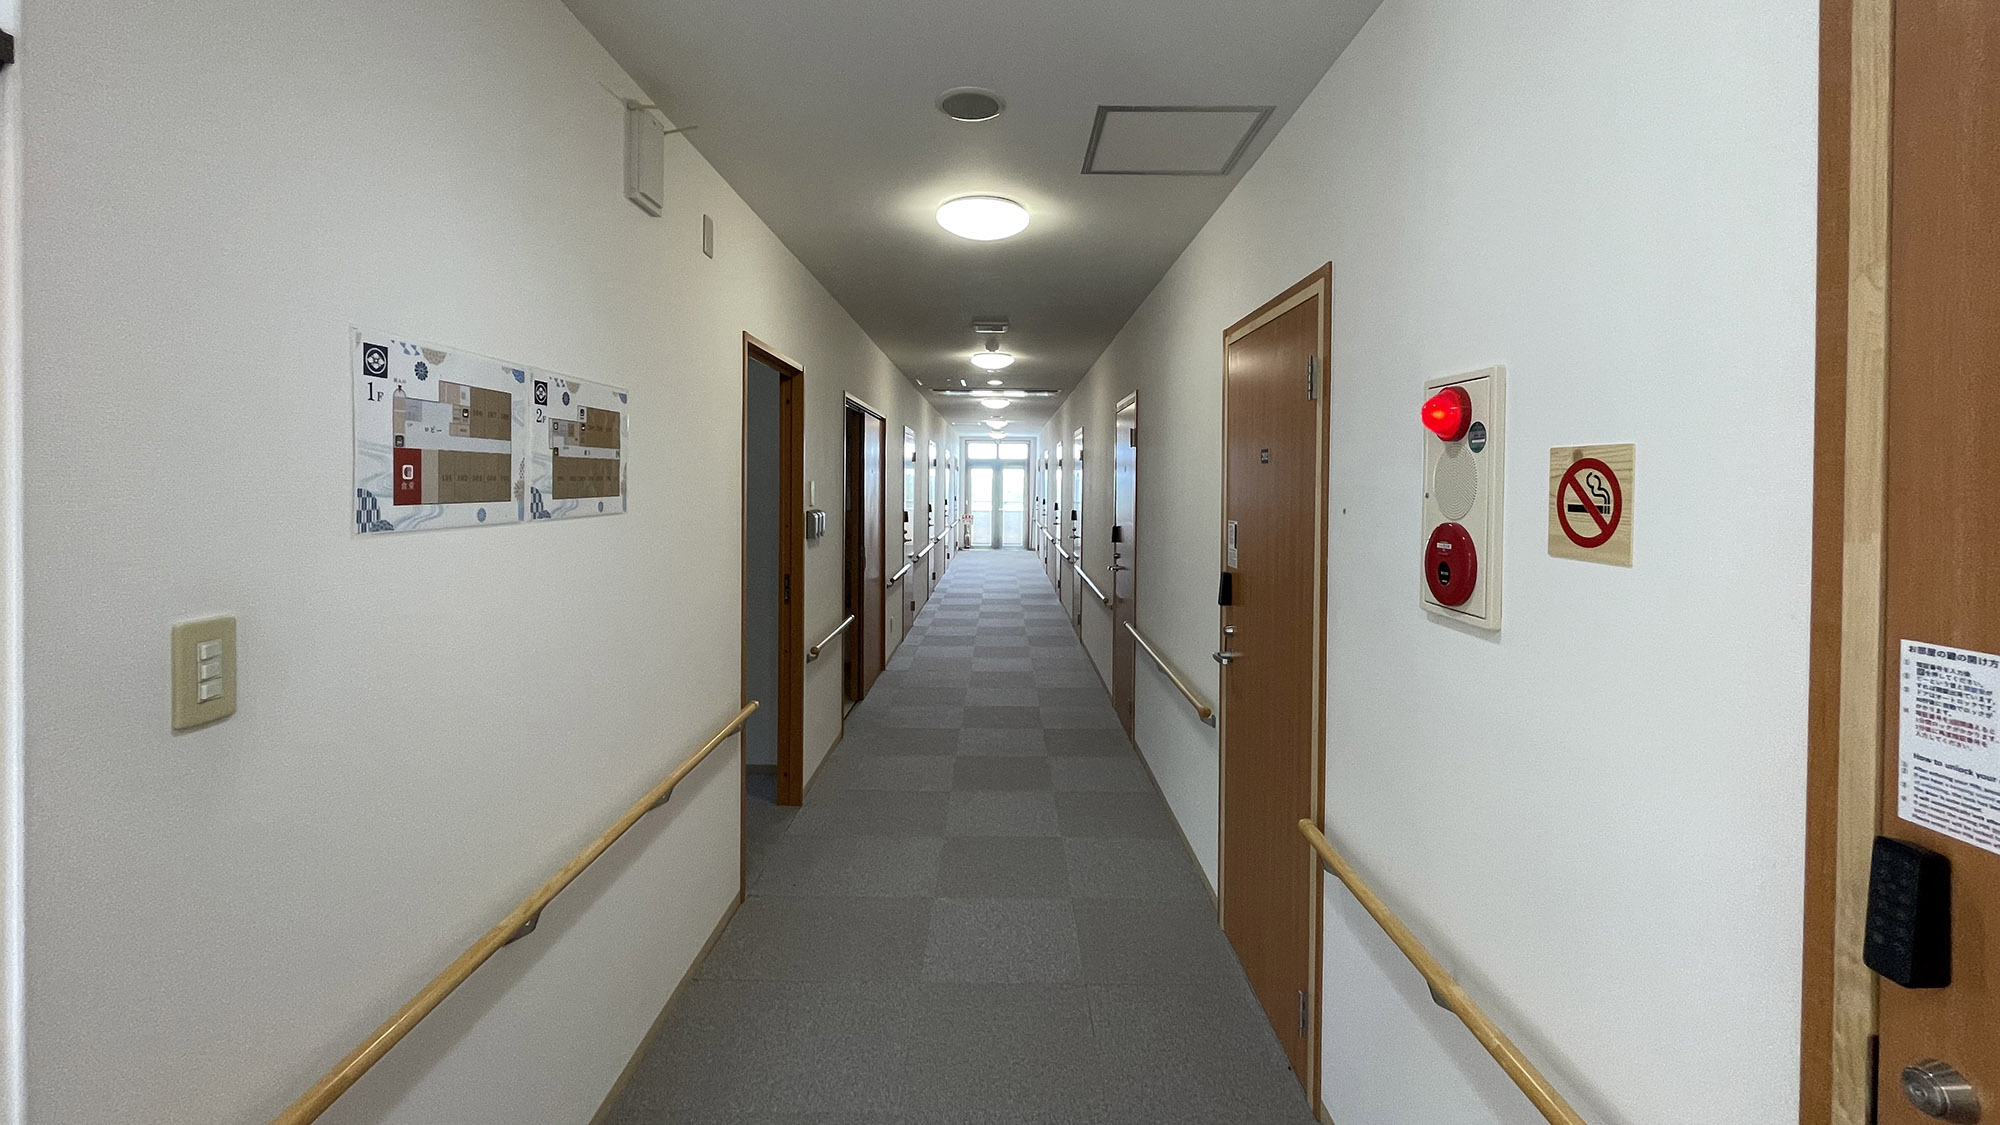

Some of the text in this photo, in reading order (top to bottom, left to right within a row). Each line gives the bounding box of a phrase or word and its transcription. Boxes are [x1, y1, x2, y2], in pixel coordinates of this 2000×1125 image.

[367, 382, 384, 403] 1F
[536, 408, 547, 423] 2F
[423, 426, 443, 435] ロビー
[1914, 753, 1996, 783] How to unlock your
